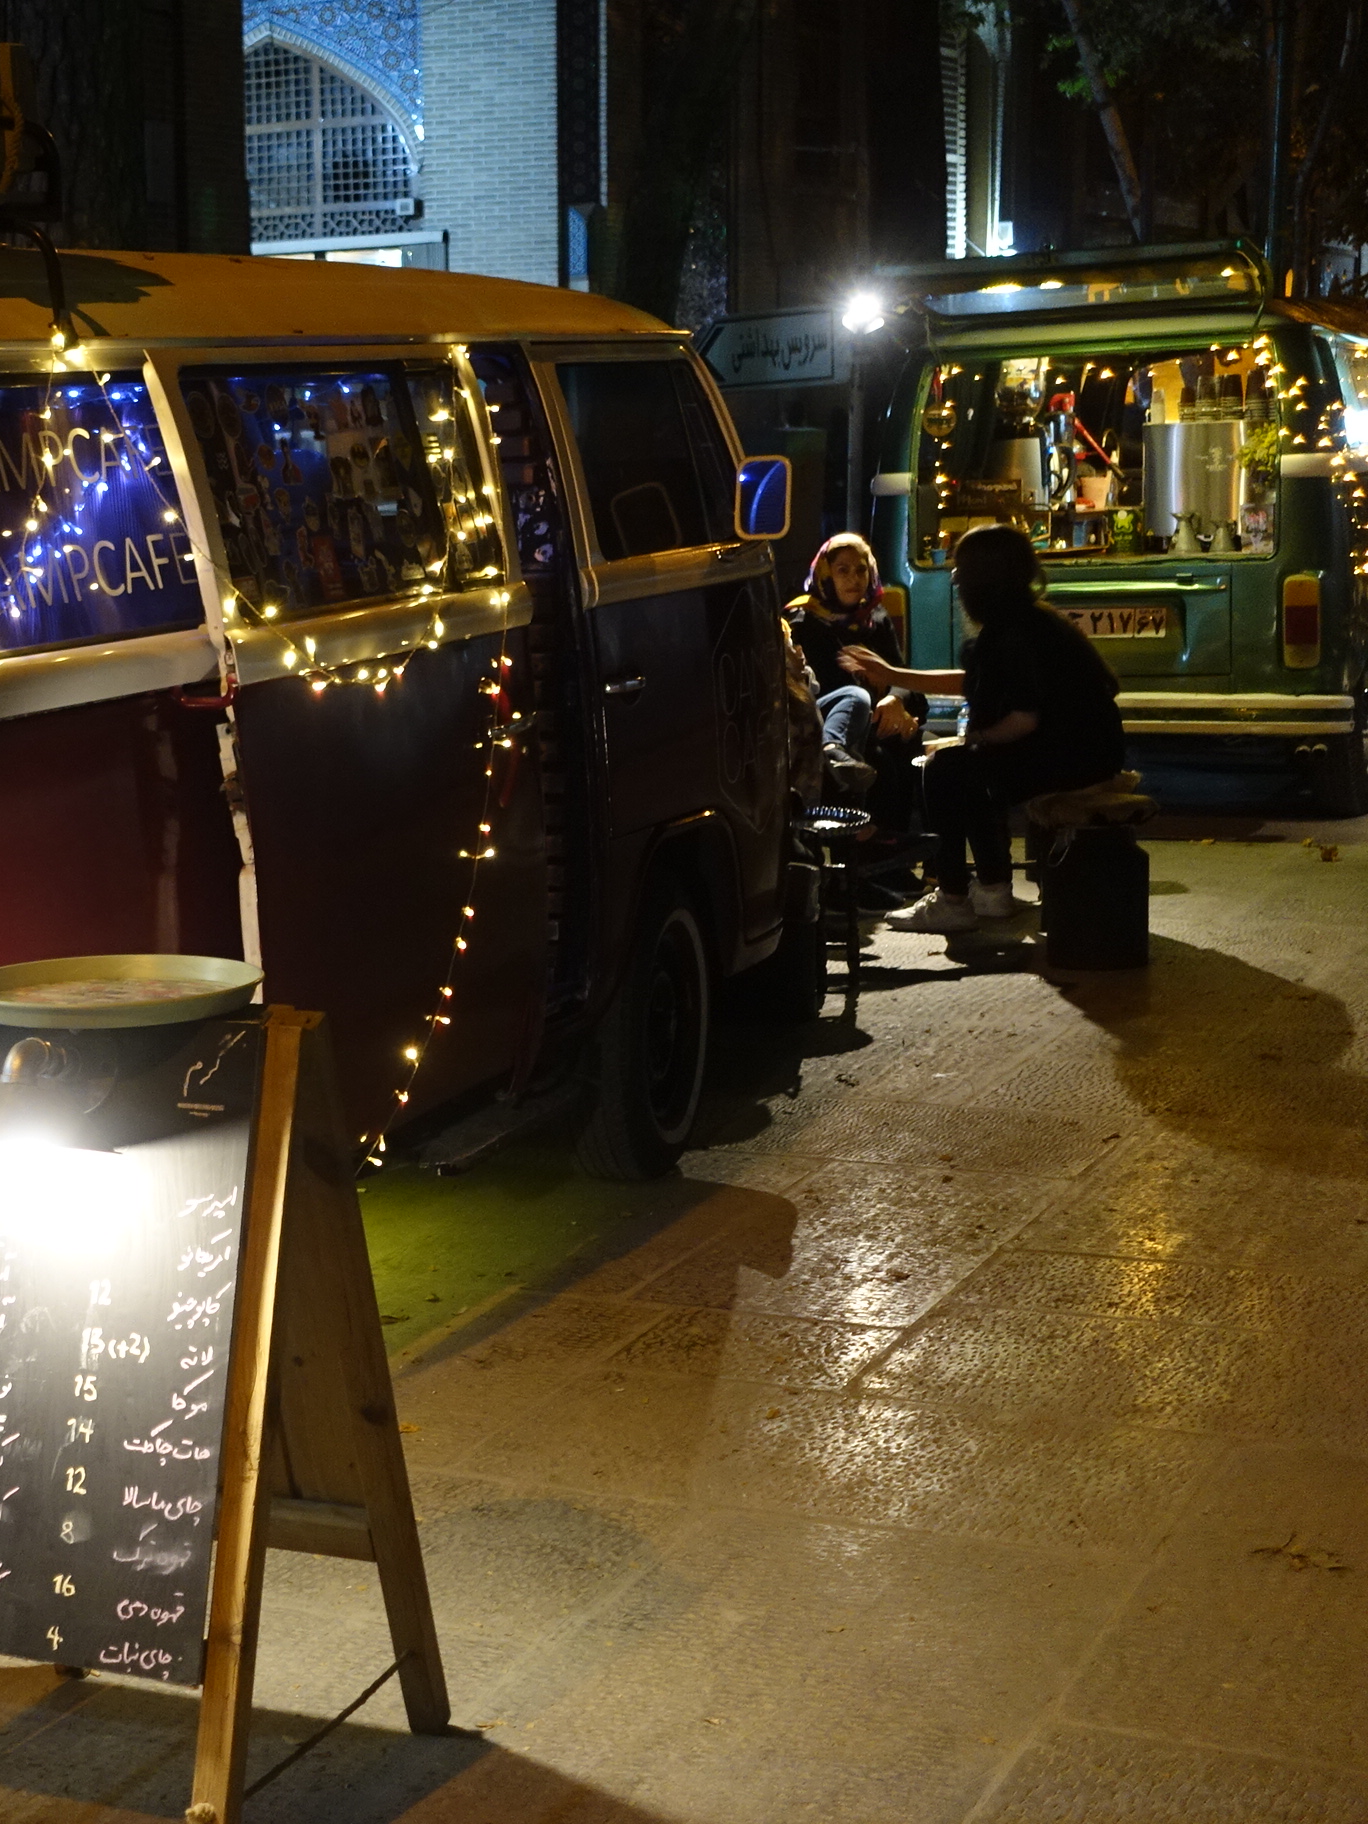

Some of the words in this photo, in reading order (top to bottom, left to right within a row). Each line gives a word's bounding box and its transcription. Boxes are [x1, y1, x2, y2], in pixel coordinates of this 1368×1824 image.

[89, 1278, 112, 1306] 12
[74, 1374, 98, 1401] 15
[67, 1417, 95, 1443] 14
[65, 1466, 88, 1495] 12
[60, 1521, 75, 1545] 8
[52, 1573, 76, 1597] 16
